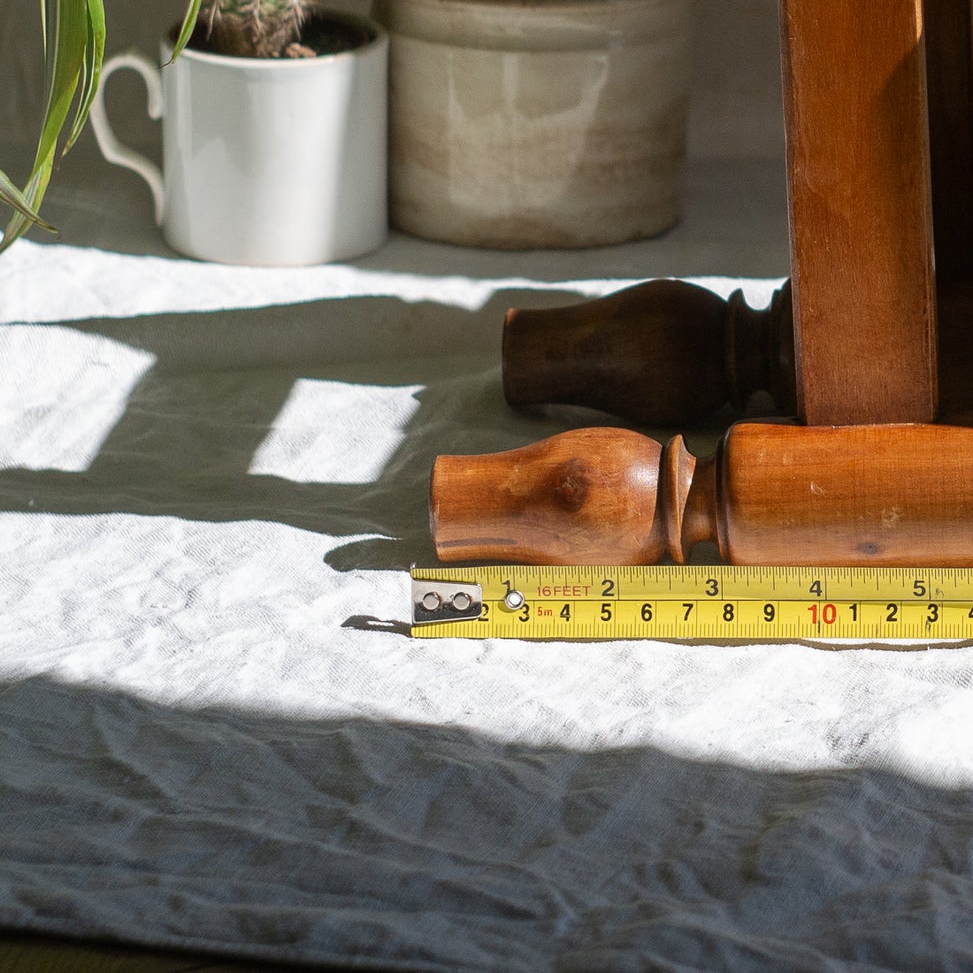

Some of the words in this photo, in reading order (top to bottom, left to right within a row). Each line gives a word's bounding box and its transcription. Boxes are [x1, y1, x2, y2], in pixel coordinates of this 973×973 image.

[537, 586, 552, 596] 16
[553, 586, 591, 596] FEET
[601, 579, 615, 597] 2
[705, 579, 719, 596] 3
[809, 580, 822, 597] 4
[913, 580, 926, 597] 5
[477, 604, 489, 622] 2
[518, 604, 530, 622] 3
[560, 603, 571, 622] 4
[600, 603, 612, 622] 5
[641, 603, 653, 622] 6
[682, 603, 694, 621] 7
[723, 603, 734, 622] 8
[763, 603, 775, 622] 9
[808, 604, 837, 625] 10
[849, 603, 857, 621] 1
[886, 603, 898, 622] 2
[927, 603, 939, 623] 3
[537, 606, 553, 617] 5m
